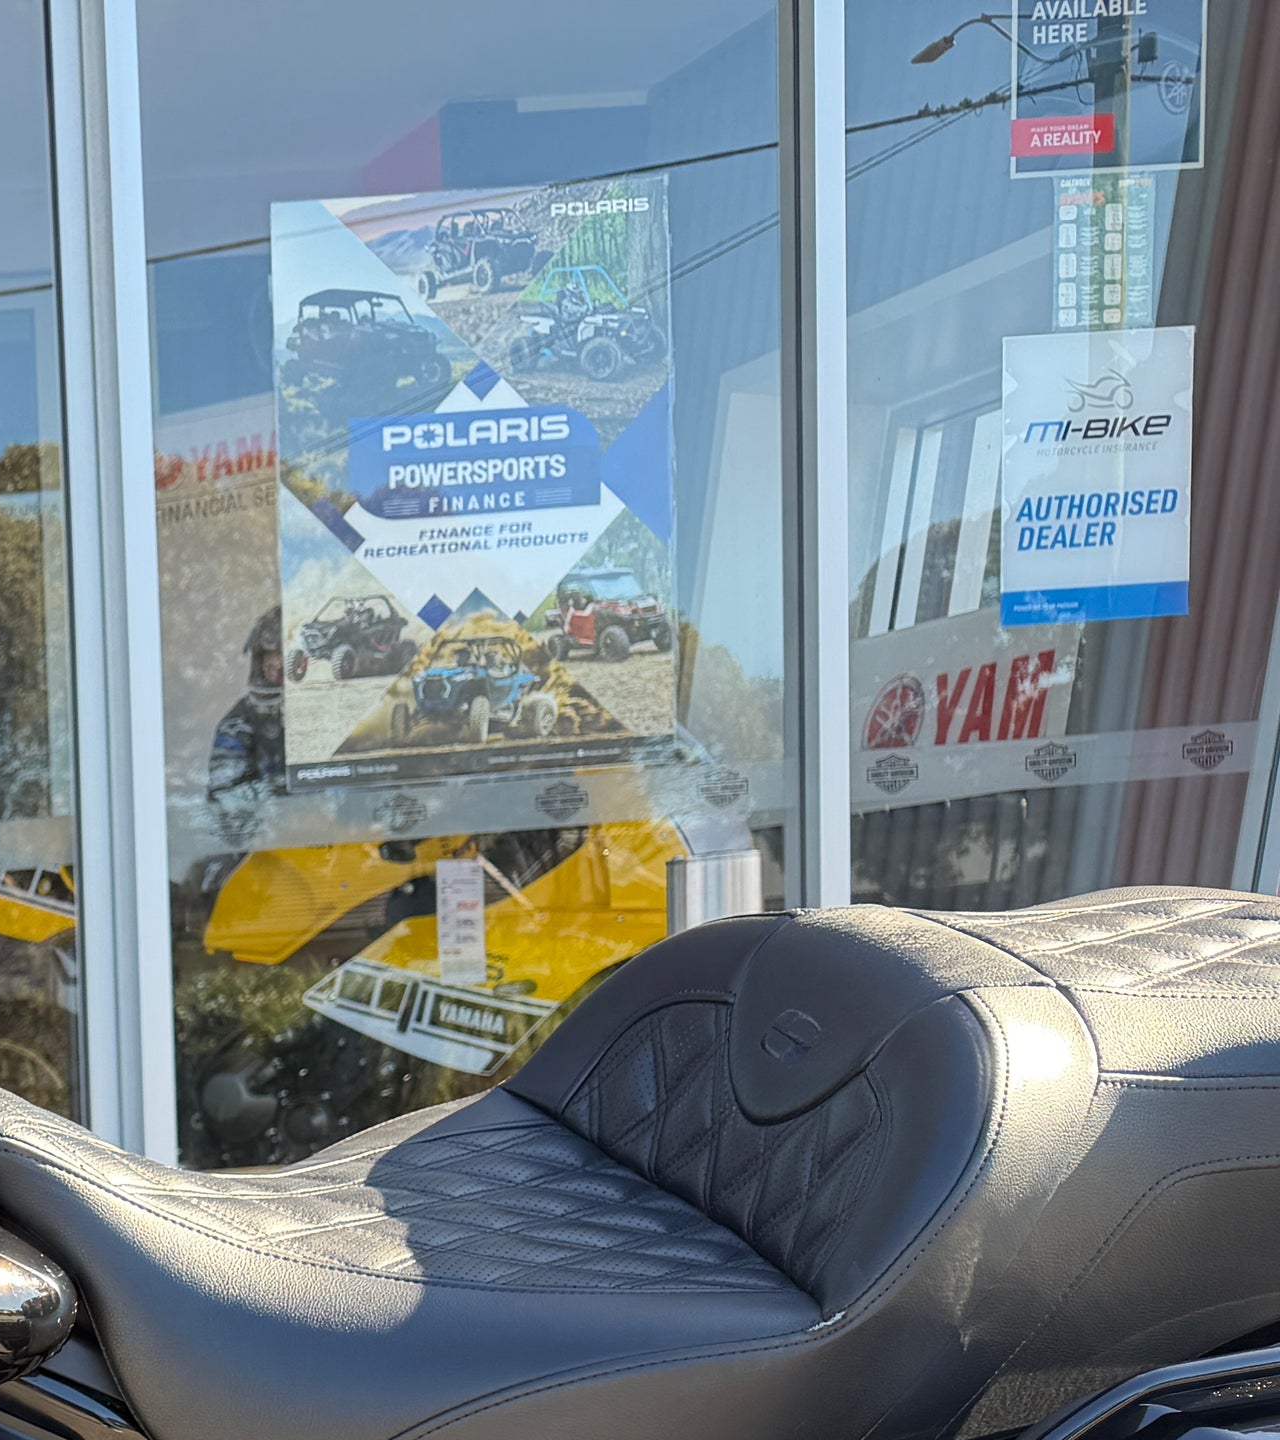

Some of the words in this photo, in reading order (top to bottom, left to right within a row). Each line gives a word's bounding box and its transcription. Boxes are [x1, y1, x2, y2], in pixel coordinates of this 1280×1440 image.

[1033, 23, 1088, 45] HERE
[1030, 134, 1042, 148] A
[1043, 130, 1101, 147] REALITY
[551, 197, 649, 218] POLARIS
[382, 414, 570, 451] POLARIS
[1037, 444, 1099, 457] MOTORCYCLE
[1102, 440, 1159, 454] INSURANCE
[390, 454, 567, 489] POWERSPORTS
[429, 491, 527, 513] FINANCE
[1016, 488, 1178, 522] AUTHORISED
[419, 523, 494, 542] FINANCE
[499, 521, 533, 535] FOR
[1018, 521, 1117, 551] DEALER
[364, 541, 492, 559] RECREATIONAL
[497, 531, 589, 549] PRODUCTS
[440, 1001, 505, 1036] YAMAHA
